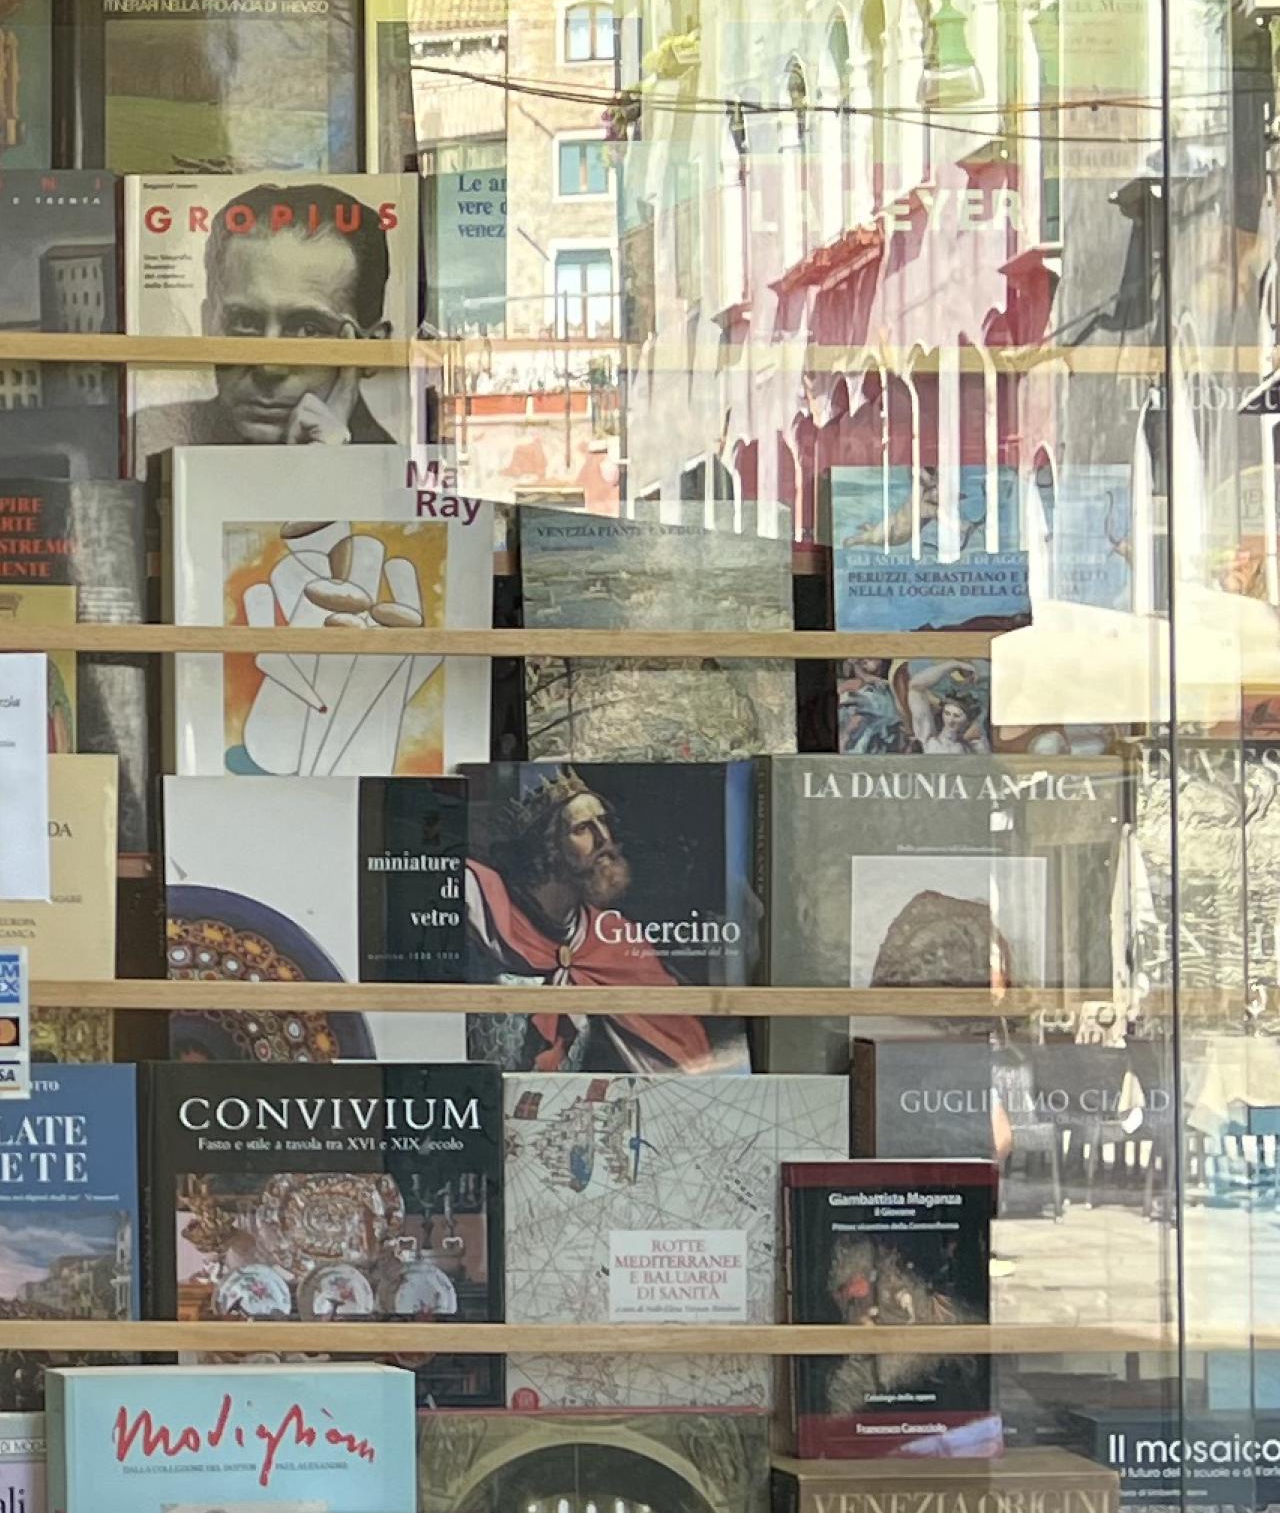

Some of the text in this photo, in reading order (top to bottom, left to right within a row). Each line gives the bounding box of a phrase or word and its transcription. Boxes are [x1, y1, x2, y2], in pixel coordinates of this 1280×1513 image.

[458, 173, 482, 193] Le
[143, 202, 400, 234] GROPIUS
[457, 200, 493, 216] vere
[415, 490, 482, 525] Ray
[915, 571, 1006, 584] SEBASTIANO
[847, 585, 897, 598] NELLA
[959, 584, 1009, 598] DELLA
[803, 772, 843, 800] LA
[850, 773, 968, 800] DAUNIA
[367, 850, 461, 873] miniature
[439, 878, 461, 900] di
[410, 907, 461, 928] vetro
[594, 909, 742, 945] Guercino
[178, 1097, 482, 1132] CONVIVIUM
[197, 1137, 232, 1151] Fasto
[347, 1137, 375, 1151] XVI
[391, 1137, 421, 1151] XIX
[828, 1192, 963, 1209] Giambattista Maganza
[651, 1239, 706, 1254] ROTTE
[614, 1254, 742, 1269] MEDITERRANEE
[629, 1270, 728, 1285] E BALUARDI
[636, 1286, 657, 1300] DI
[1135, 1432, 1280, 1464] mosaico
